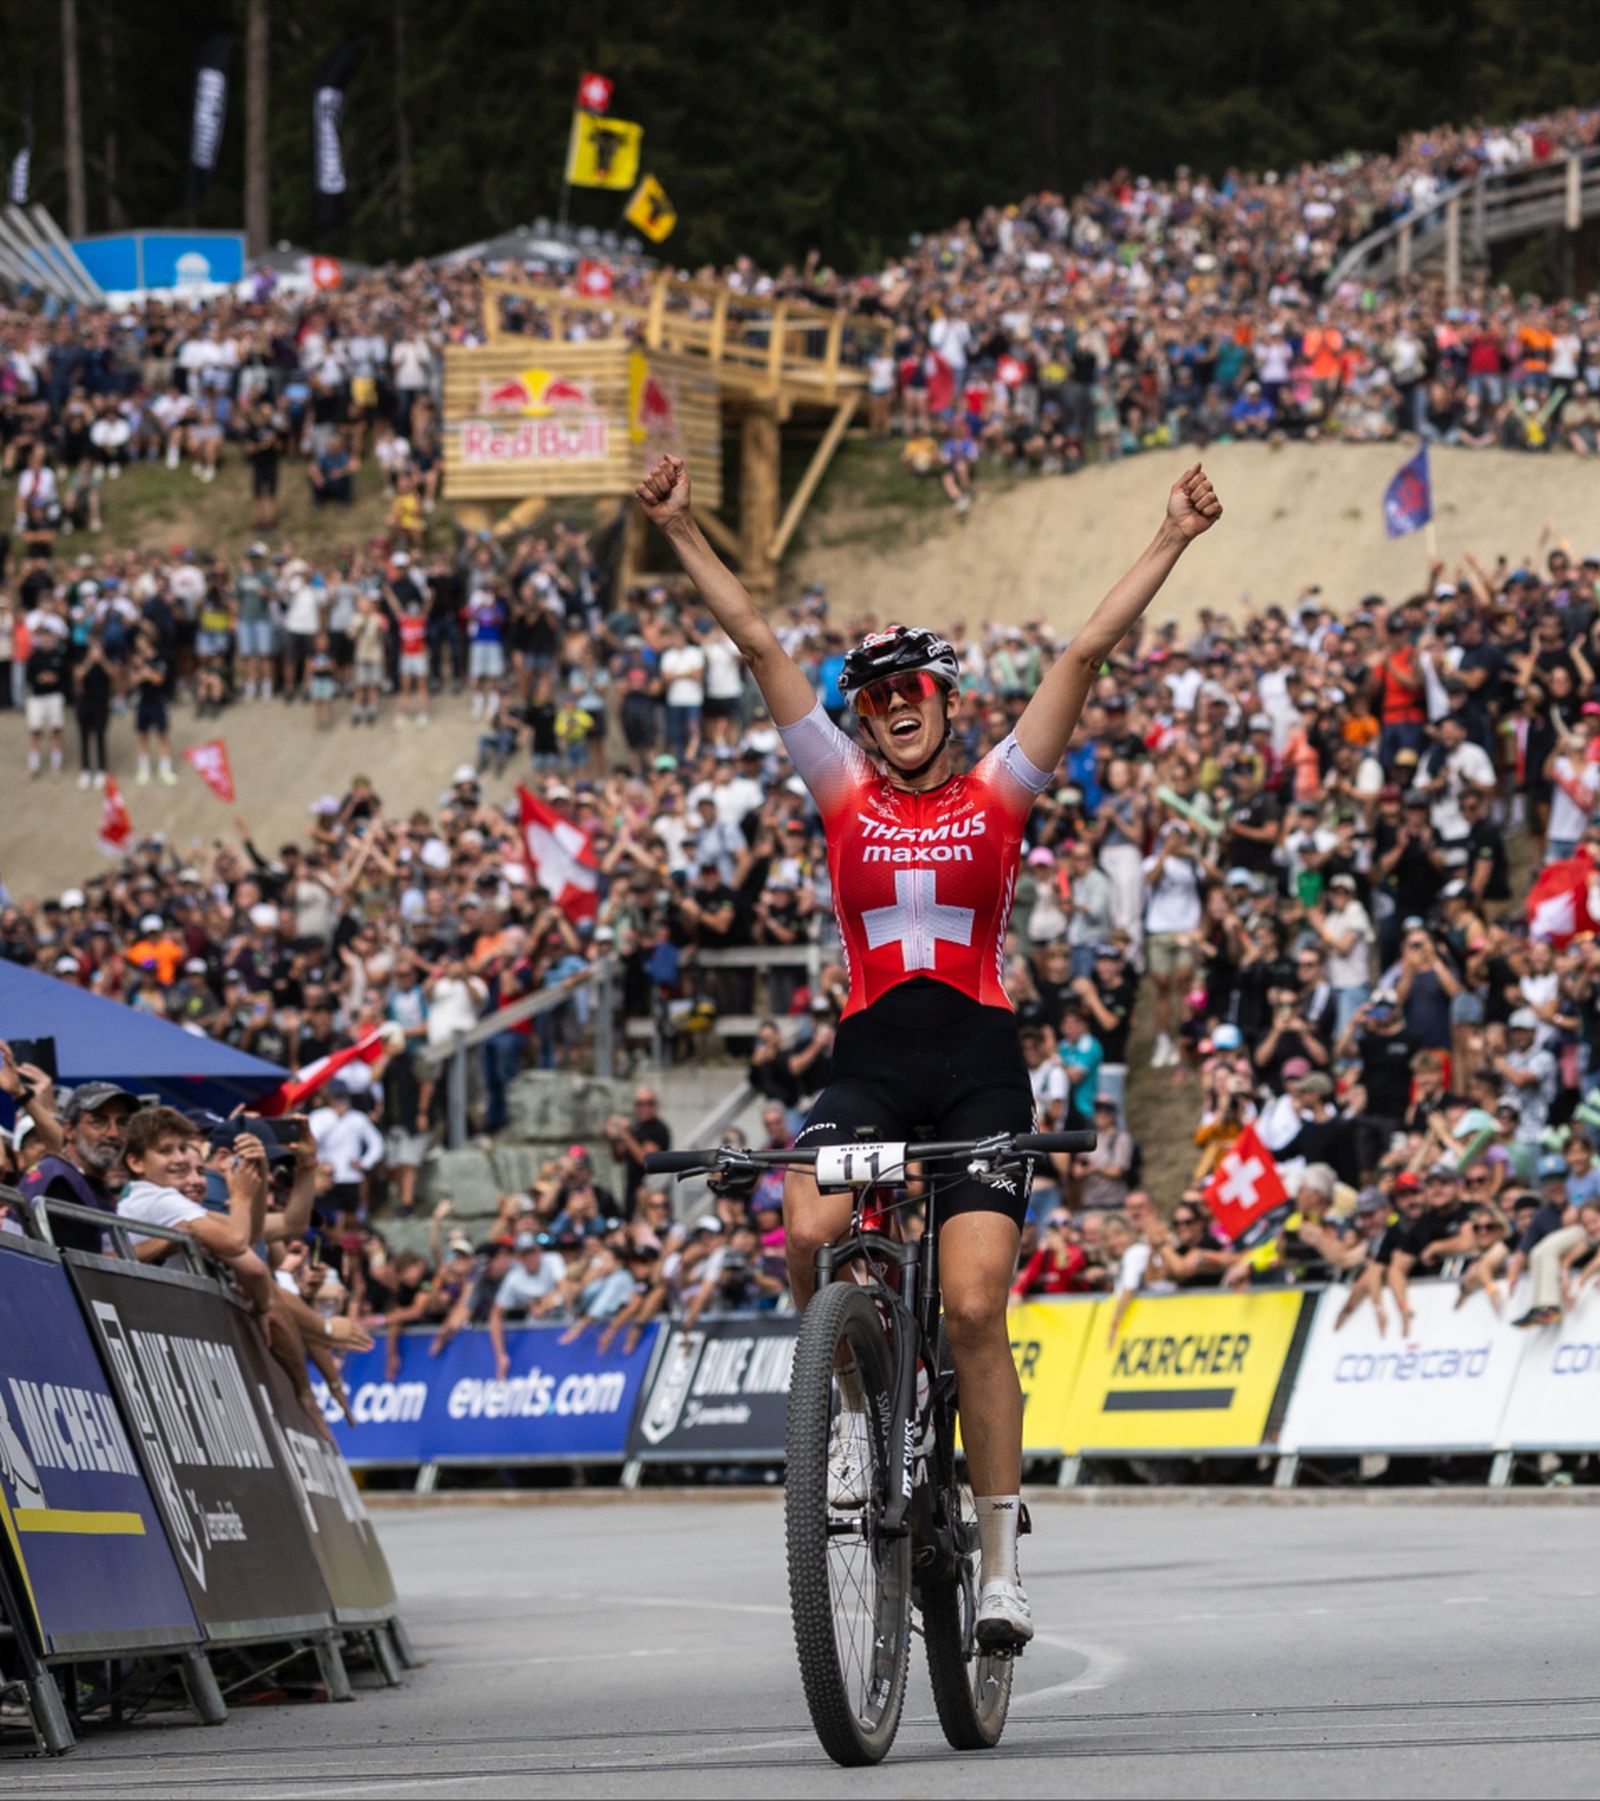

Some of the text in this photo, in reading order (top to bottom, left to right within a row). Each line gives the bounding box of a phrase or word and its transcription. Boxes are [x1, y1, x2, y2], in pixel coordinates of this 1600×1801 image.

[463, 416, 608, 462] Red Bull
[862, 845, 974, 862] maxon
[837, 1152, 880, 1181] 11
[129, 1329, 208, 1466] BIKE
[448, 1365, 626, 1420] events.com
[903, 1418, 915, 1466] SWISS
